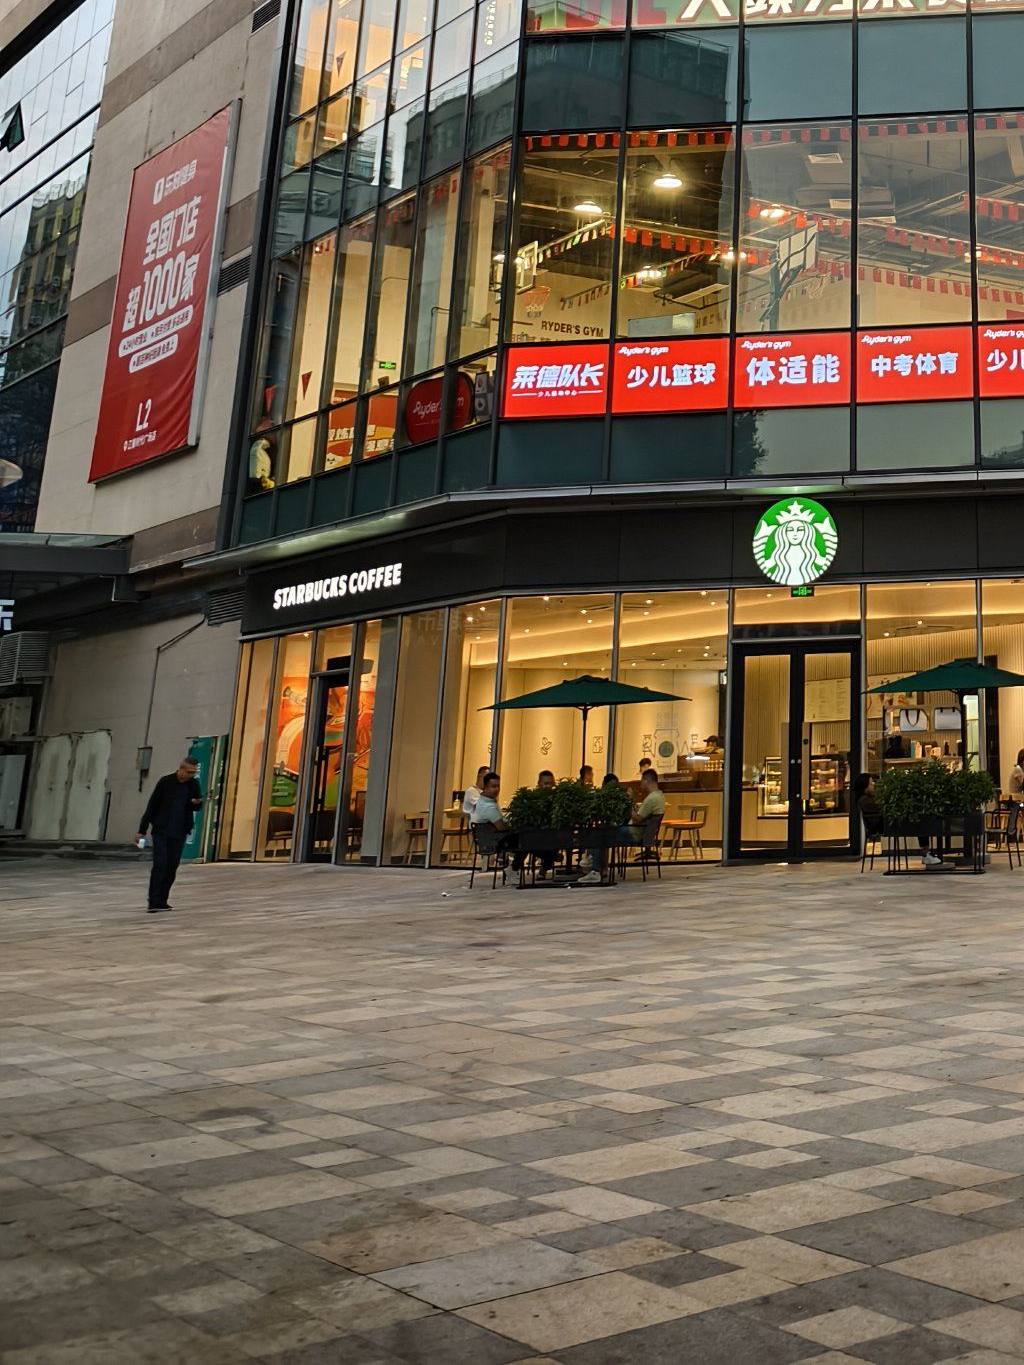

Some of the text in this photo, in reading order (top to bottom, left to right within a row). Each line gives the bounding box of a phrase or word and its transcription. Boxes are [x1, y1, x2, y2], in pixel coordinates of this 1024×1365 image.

[142, 196, 201, 266] 全国门店
[122, 251, 200, 333] 超1000家
[541, 320, 581, 335] RYDER'S
[583, 326, 604, 337] GYM
[511, 362, 605, 390] 莱德队长
[626, 362, 717, 388] 少儿篮球
[746, 354, 841, 387] 体适能
[870, 351, 959, 378] 中考体育
[136, 399, 152, 431] L2
[273, 562, 402, 610] STARBUCKS COFFEE
